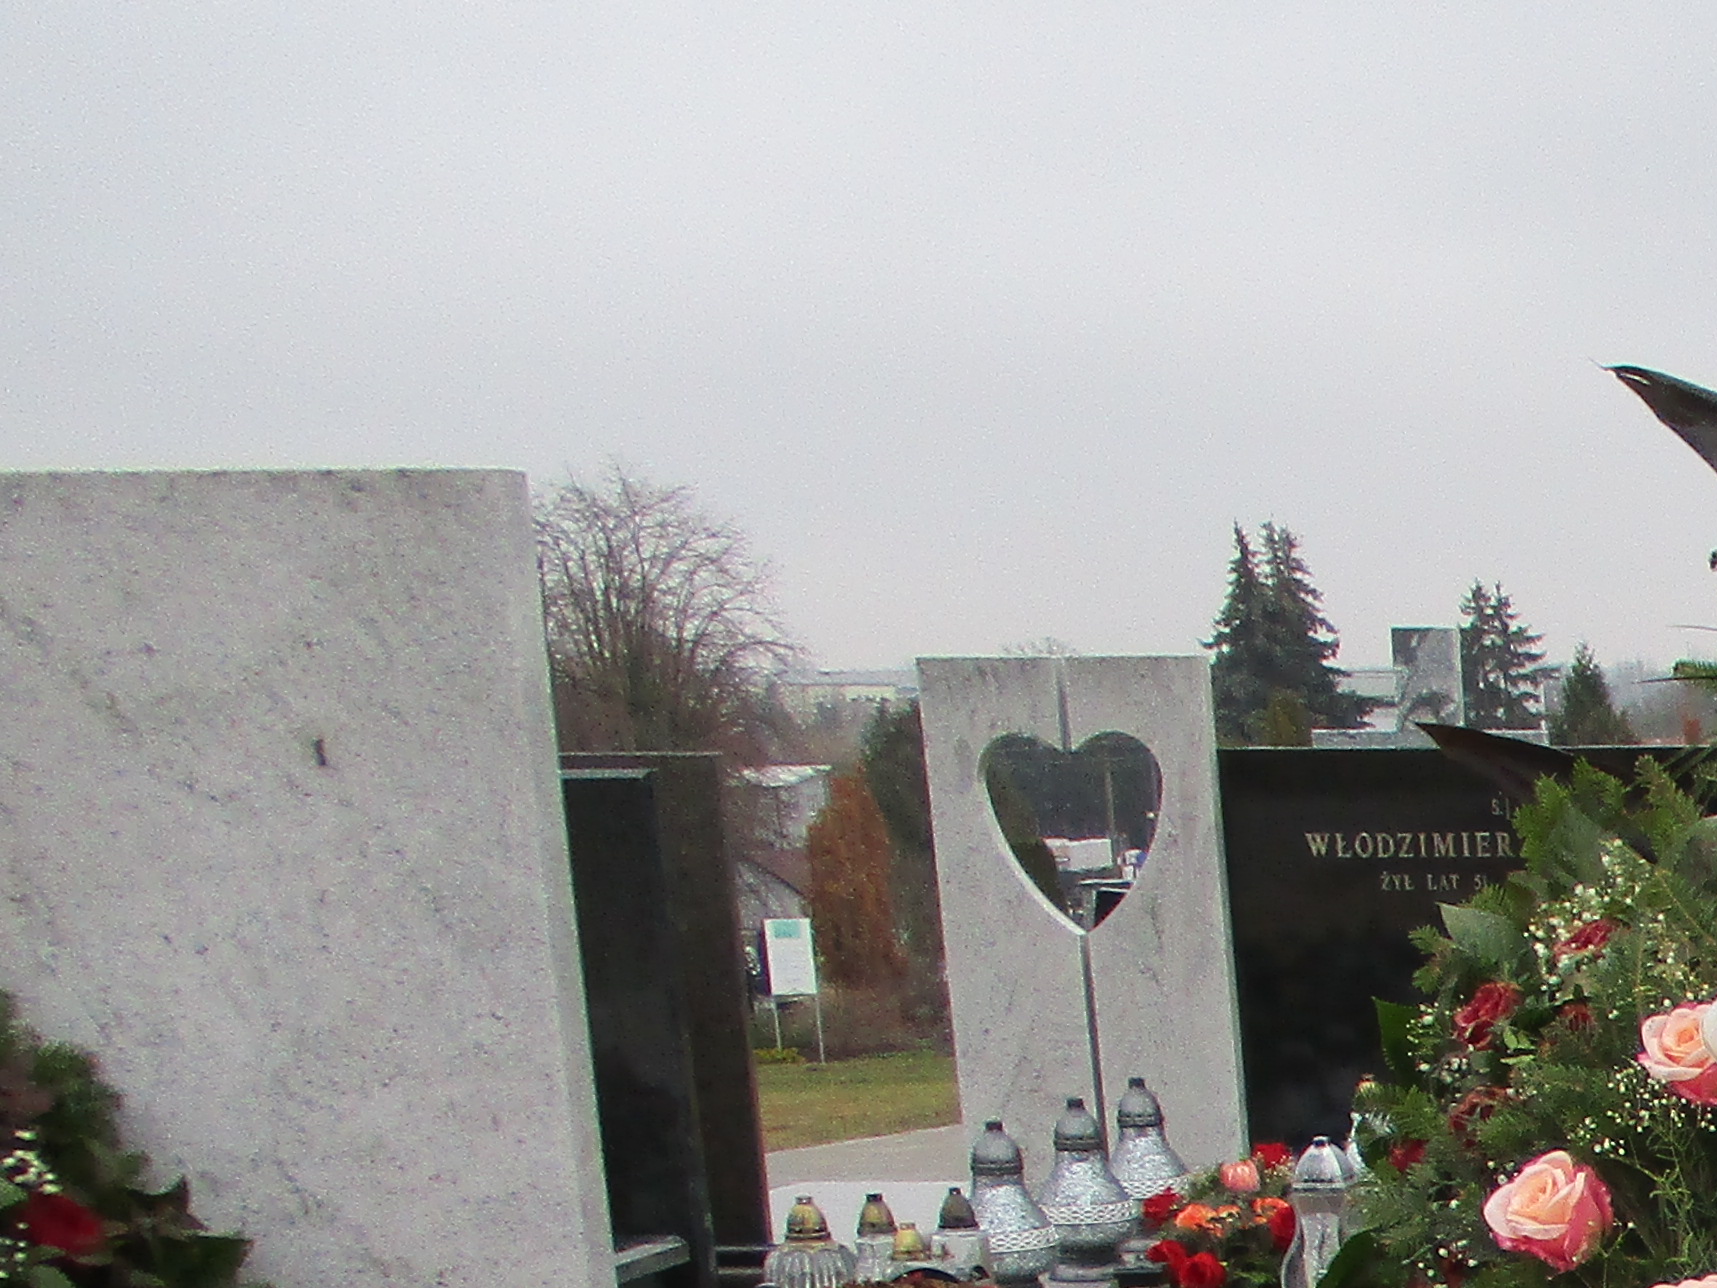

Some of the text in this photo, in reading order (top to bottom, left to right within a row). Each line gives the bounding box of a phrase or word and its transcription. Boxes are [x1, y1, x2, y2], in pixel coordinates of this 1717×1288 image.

[1304, 831, 1520, 860] WŁODZIMIER
[1380, 870, 1415, 891] ŻYŁ
[1427, 874, 1460, 891] LAT
